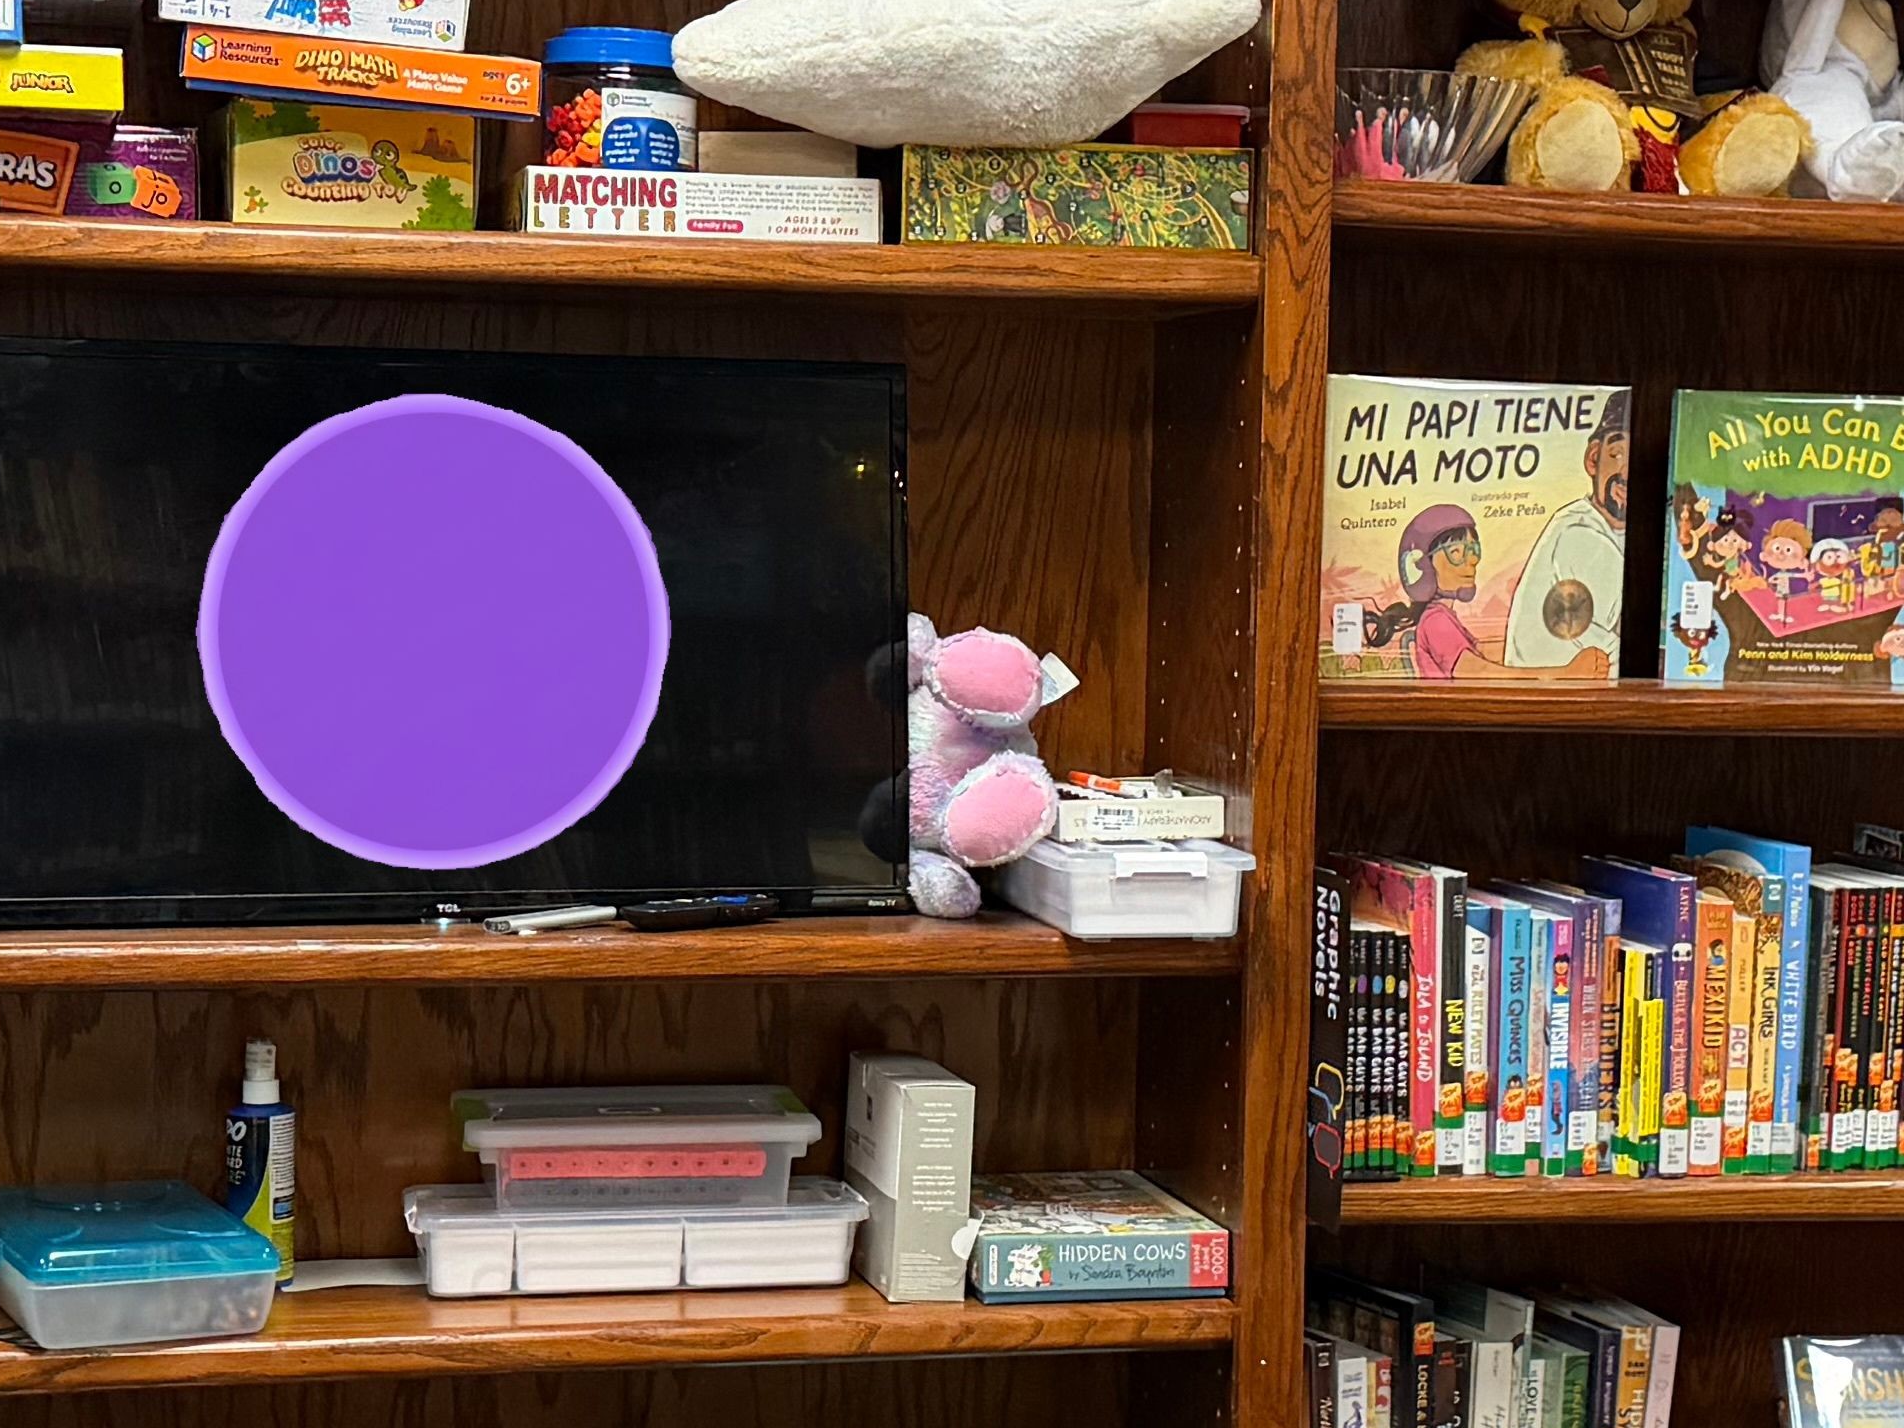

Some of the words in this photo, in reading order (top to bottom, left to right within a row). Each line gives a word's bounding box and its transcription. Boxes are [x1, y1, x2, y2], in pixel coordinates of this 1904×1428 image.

[295, 50, 346, 69] DINO
[349, 51, 399, 81] MATH
[316, 69, 381, 88] TRACKS
[505, 72, 532, 95] 6+
[534, 173, 677, 208] MATCHING
[534, 208, 676, 232] LETTER
[1344, 403, 1389, 442] MI
[1405, 400, 1480, 440] PAPI
[1494, 394, 1595, 434] TIENE
[1707, 418, 1748, 459] All
[1756, 410, 1811, 439] You
[1822, 409, 1881, 443] Can
[1336, 449, 1418, 488] UNA
[1433, 444, 1540, 483] MOTO
[1743, 446, 1791, 473] with
[1797, 443, 1892, 479] ADHD
[1370, 498, 1407, 511] Isabel
[1483, 505, 1514, 519] Zeke
[1516, 503, 1546, 517] Peña
[1340, 517, 1397, 531] Quintero
[1314, 885, 1328, 998] Novels
[1327, 891, 1341, 1021] Graphic
[1444, 999, 1462, 1034] NEW
[1443, 1038, 1465, 1067] KID
[1058, 1244, 1127, 1263] HIDDEN
[1133, 1243, 1186, 1261] COWS
